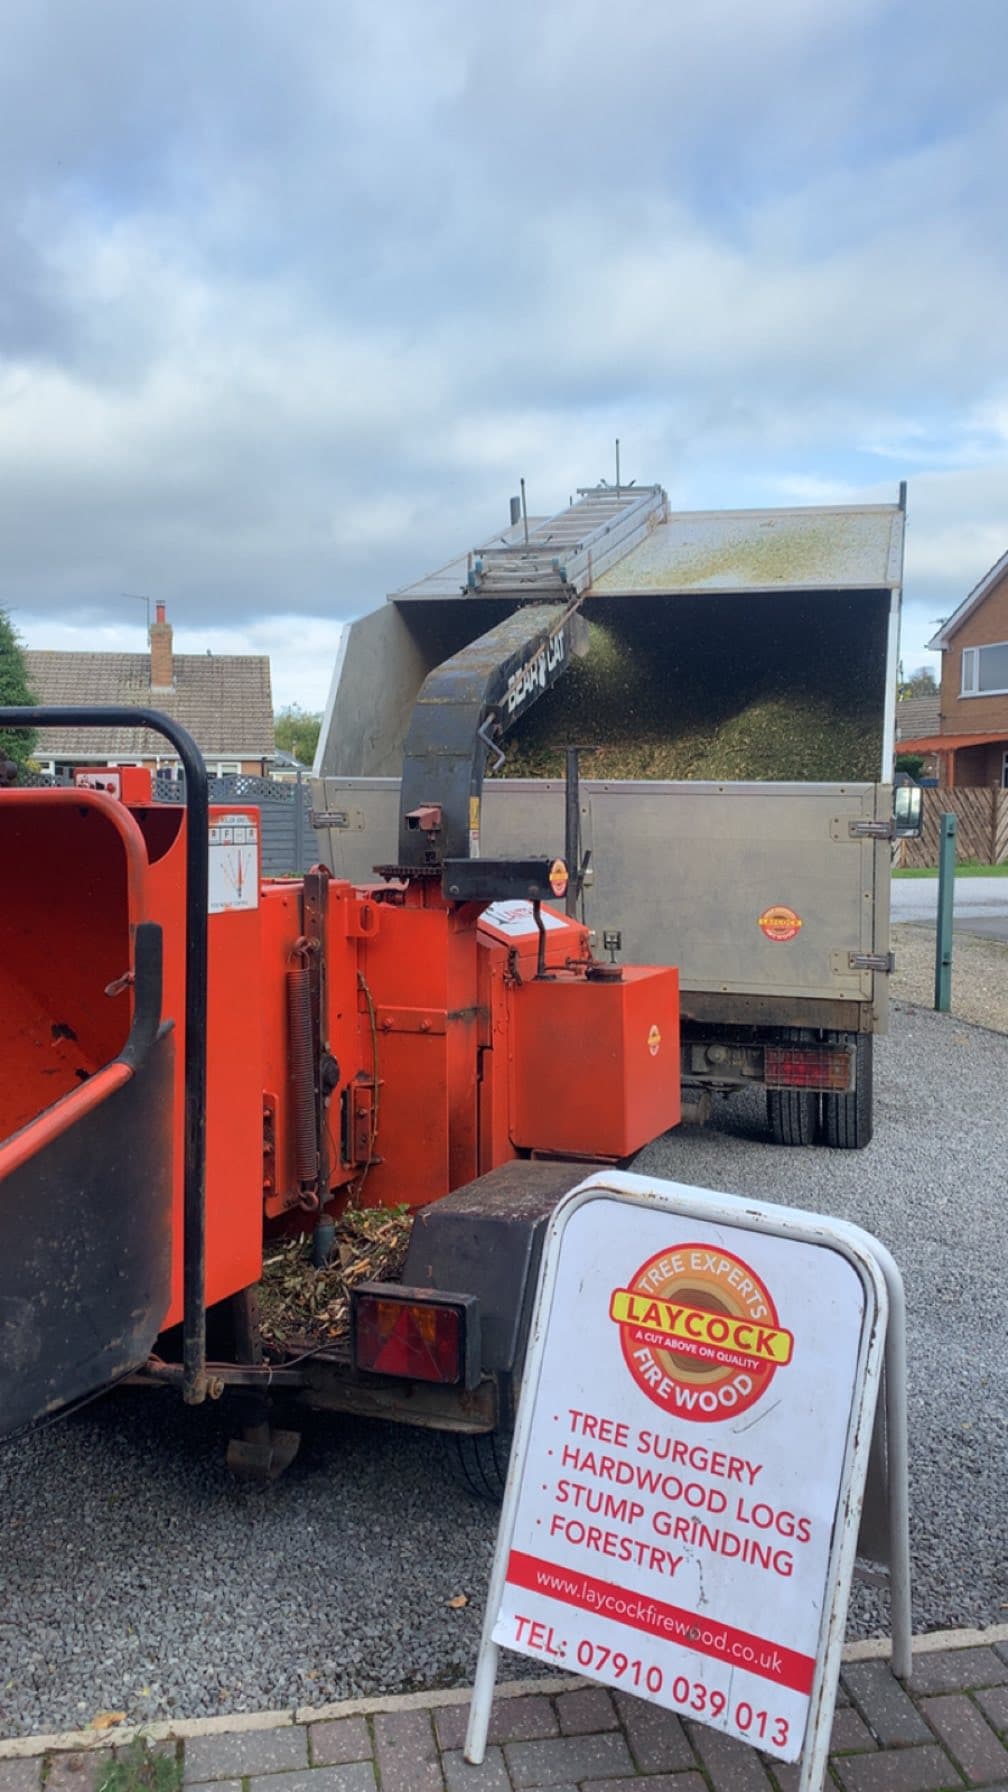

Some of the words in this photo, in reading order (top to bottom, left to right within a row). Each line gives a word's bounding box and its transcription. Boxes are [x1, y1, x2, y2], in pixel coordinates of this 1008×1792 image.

[638, 1254, 685, 1293] TREE
[690, 1252, 768, 1320] EXPERTS
[626, 1297, 778, 1357] LAYCOCK
[635, 1330, 643, 1340] A
[644, 1332, 663, 1345] CUT
[664, 1338, 697, 1354] ABOVE
[698, 1346, 715, 1359] ON
[716, 1351, 760, 1370] QUALITY
[633, 1347, 753, 1412] FIREWOOD
[568, 1409, 630, 1448] TREE
[637, 1430, 763, 1486] SURGERY
[555, 1480, 644, 1524] STUMP
[652, 1511, 793, 1577] GRINDING
[562, 1444, 727, 1514] HARDWOOD
[736, 1498, 812, 1543] LOGS
[550, 1514, 683, 1577] FORESTRY
[536, 1571, 783, 1674] www.laycockfirewood.co.uk
[514, 1615, 567, 1657] TEL:
[577, 1640, 663, 1693] 07910
[672, 1676, 726, 1717] 039
[735, 1702, 789, 1747] 013
